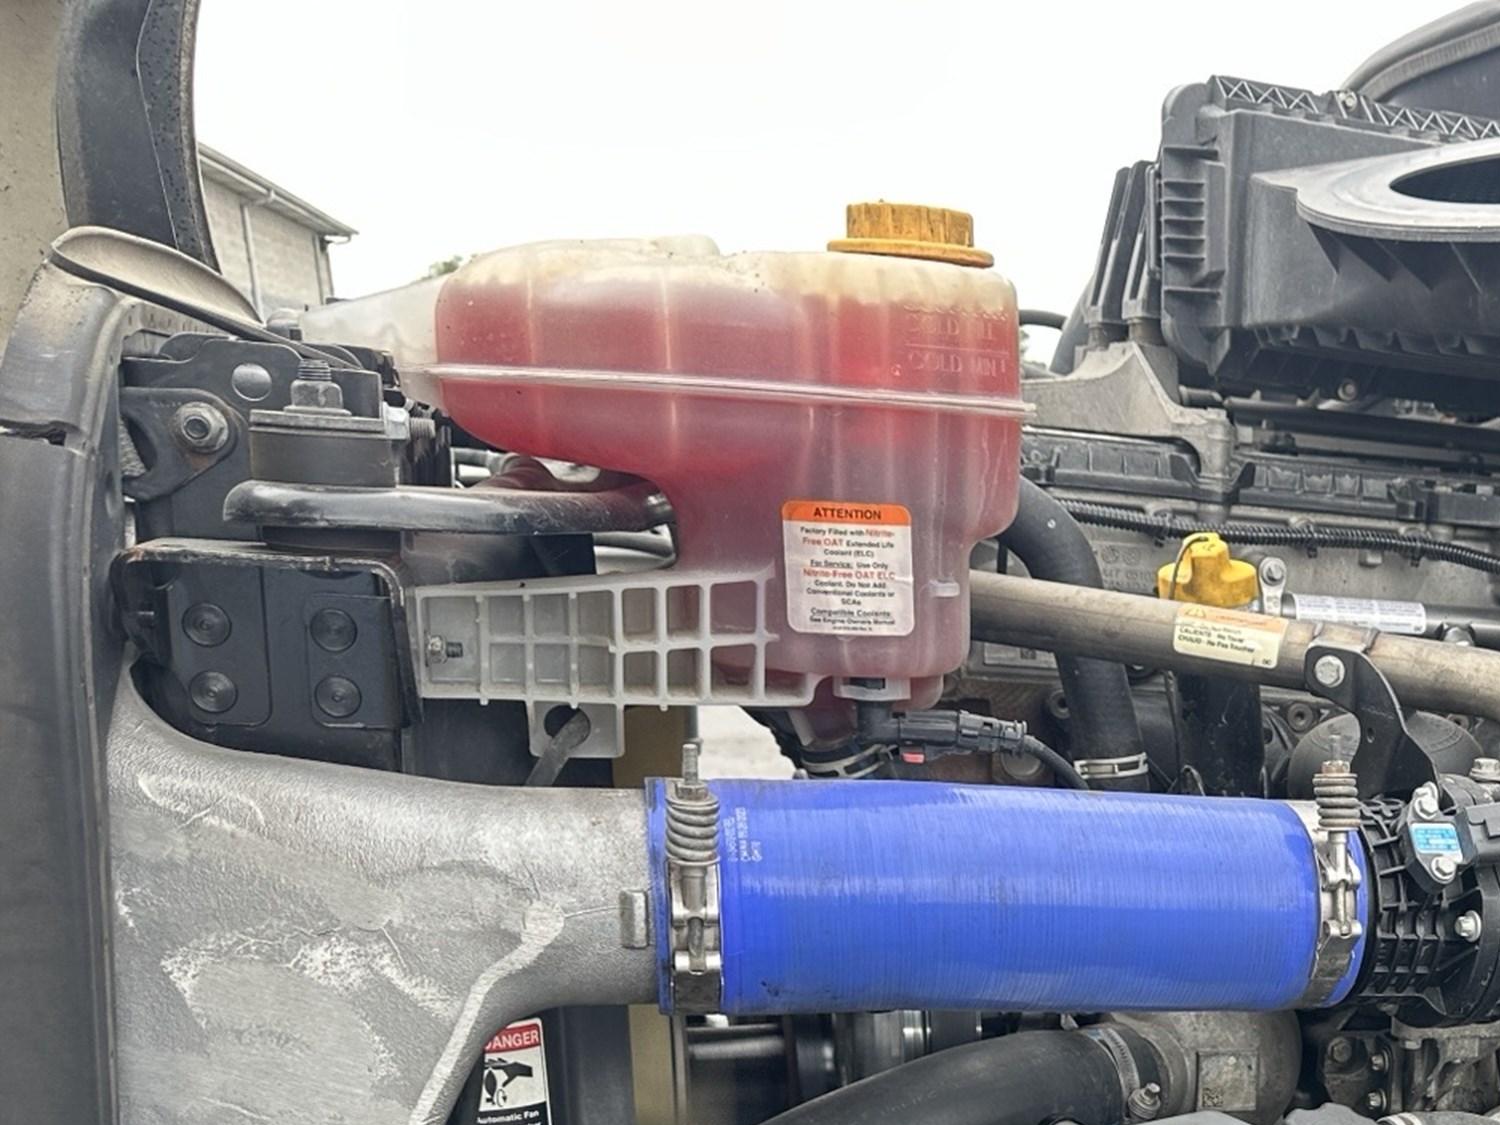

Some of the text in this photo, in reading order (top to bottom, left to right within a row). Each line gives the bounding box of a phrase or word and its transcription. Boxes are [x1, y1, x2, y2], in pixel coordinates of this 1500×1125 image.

[813, 507, 882, 520] ATTENTION
[800, 526, 826, 536] Factory
[828, 528, 847, 536] Filled
[850, 528, 865, 537] with
[802, 537, 894, 549] Free OAT Extended Life
[824, 549, 852, 557] Coolant
[873, 562, 888, 571] Only
[855, 571, 875, 580] OAT
[877, 572, 896, 581] ELC
[477, 1110, 540, 1124] Automatic Fan
